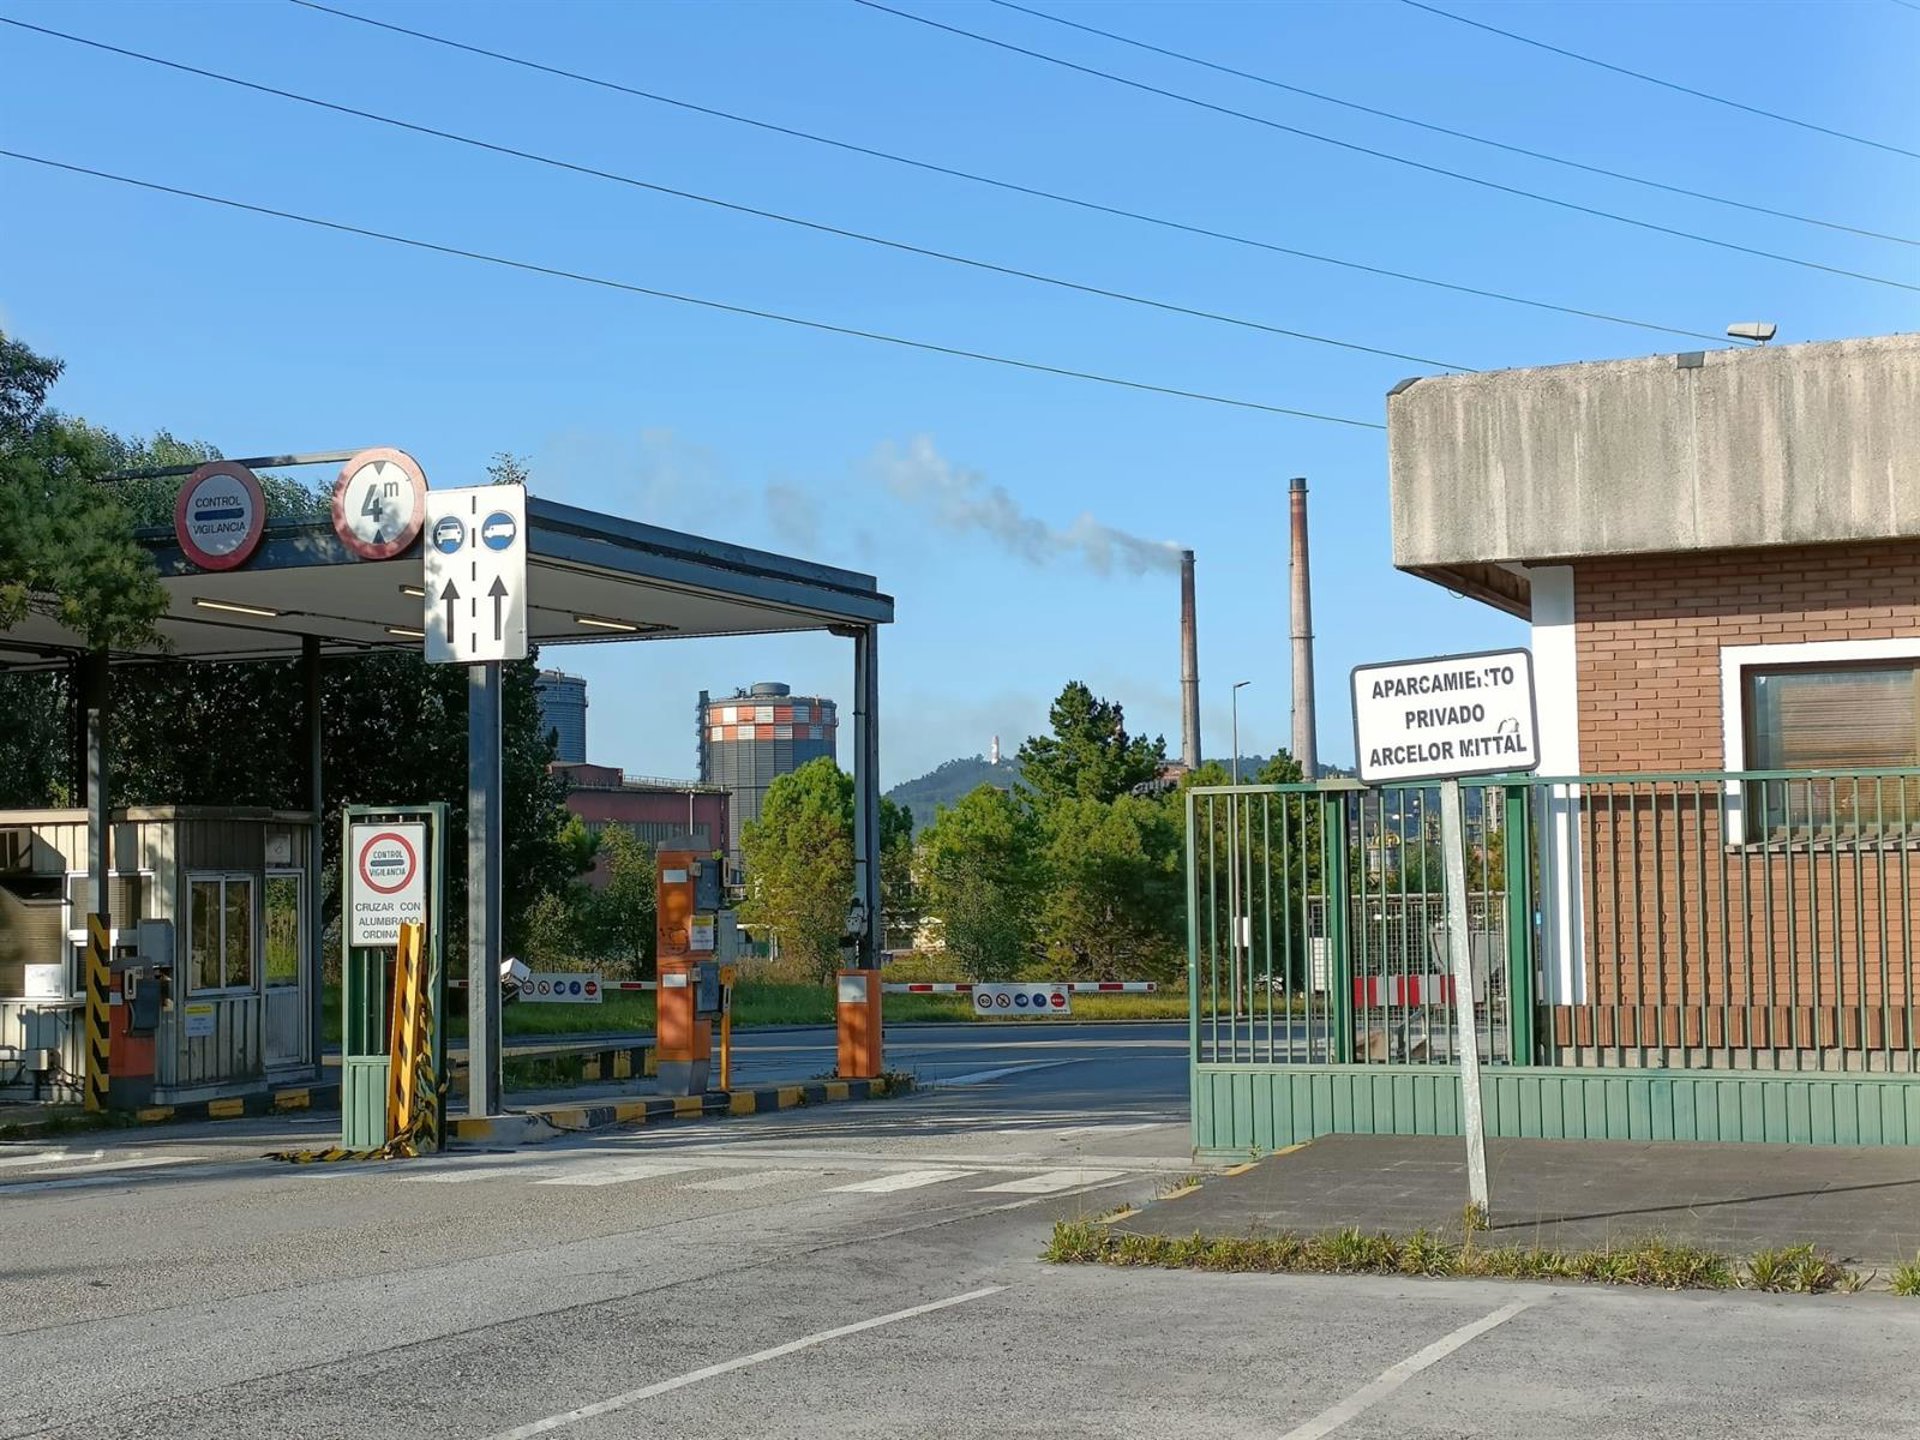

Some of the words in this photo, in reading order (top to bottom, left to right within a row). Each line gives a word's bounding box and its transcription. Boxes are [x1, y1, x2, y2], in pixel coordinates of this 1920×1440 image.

[195, 496, 242, 508] CONTROL
[192, 521, 246, 535] VIGILANCIA
[1405, 703, 1485, 729] PRIVADO
[1369, 741, 1454, 767] ARCELOR
[1459, 733, 1527, 758] MITTAL
[373, 850, 403, 859] CONTROL
[369, 867, 406, 877] VIGILANCIA
[355, 902, 395, 912] CRUZAR
[399, 901, 421, 911] CON
[358, 916, 419, 926] ALUMBRADO
[362, 929, 398, 939] ORDINA
